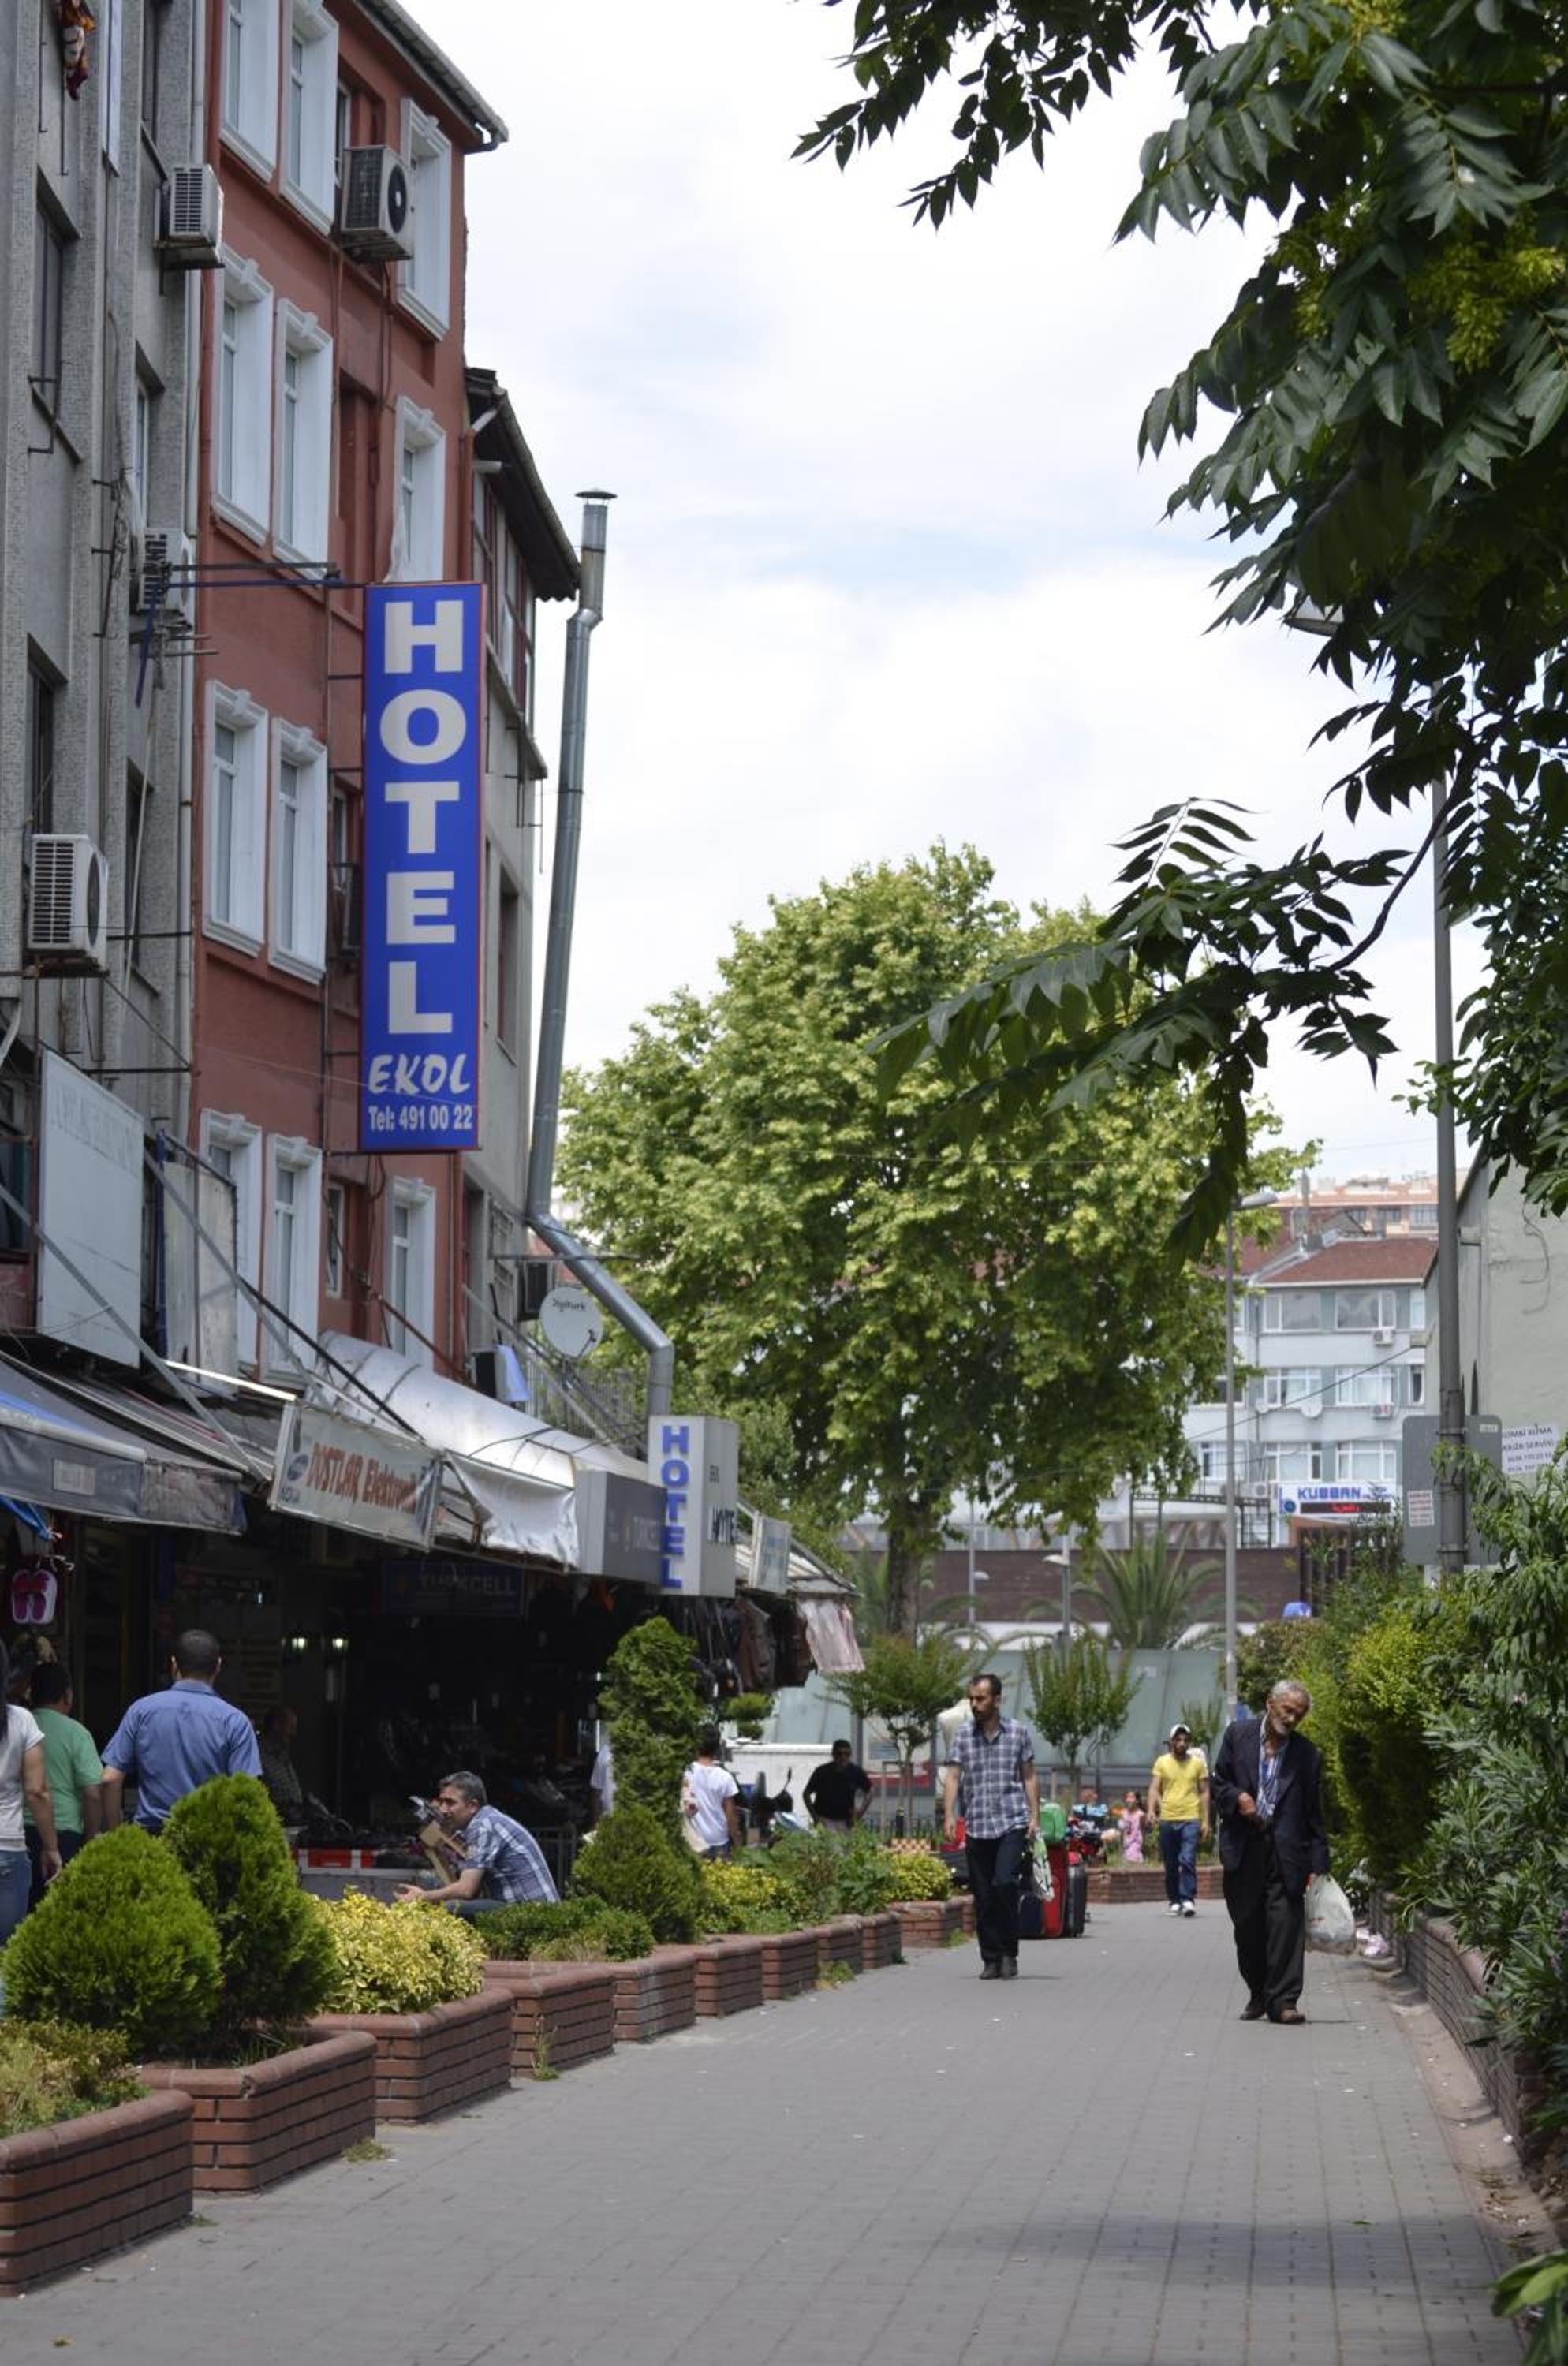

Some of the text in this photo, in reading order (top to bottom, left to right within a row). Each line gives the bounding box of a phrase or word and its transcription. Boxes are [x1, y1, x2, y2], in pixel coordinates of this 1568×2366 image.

[379, 599, 467, 1035] HOTEL
[368, 1053, 471, 1095] EKOL
[368, 1104, 472, 1131] Tel: 491 00 22
[660, 1424, 690, 1588] HOTEL
